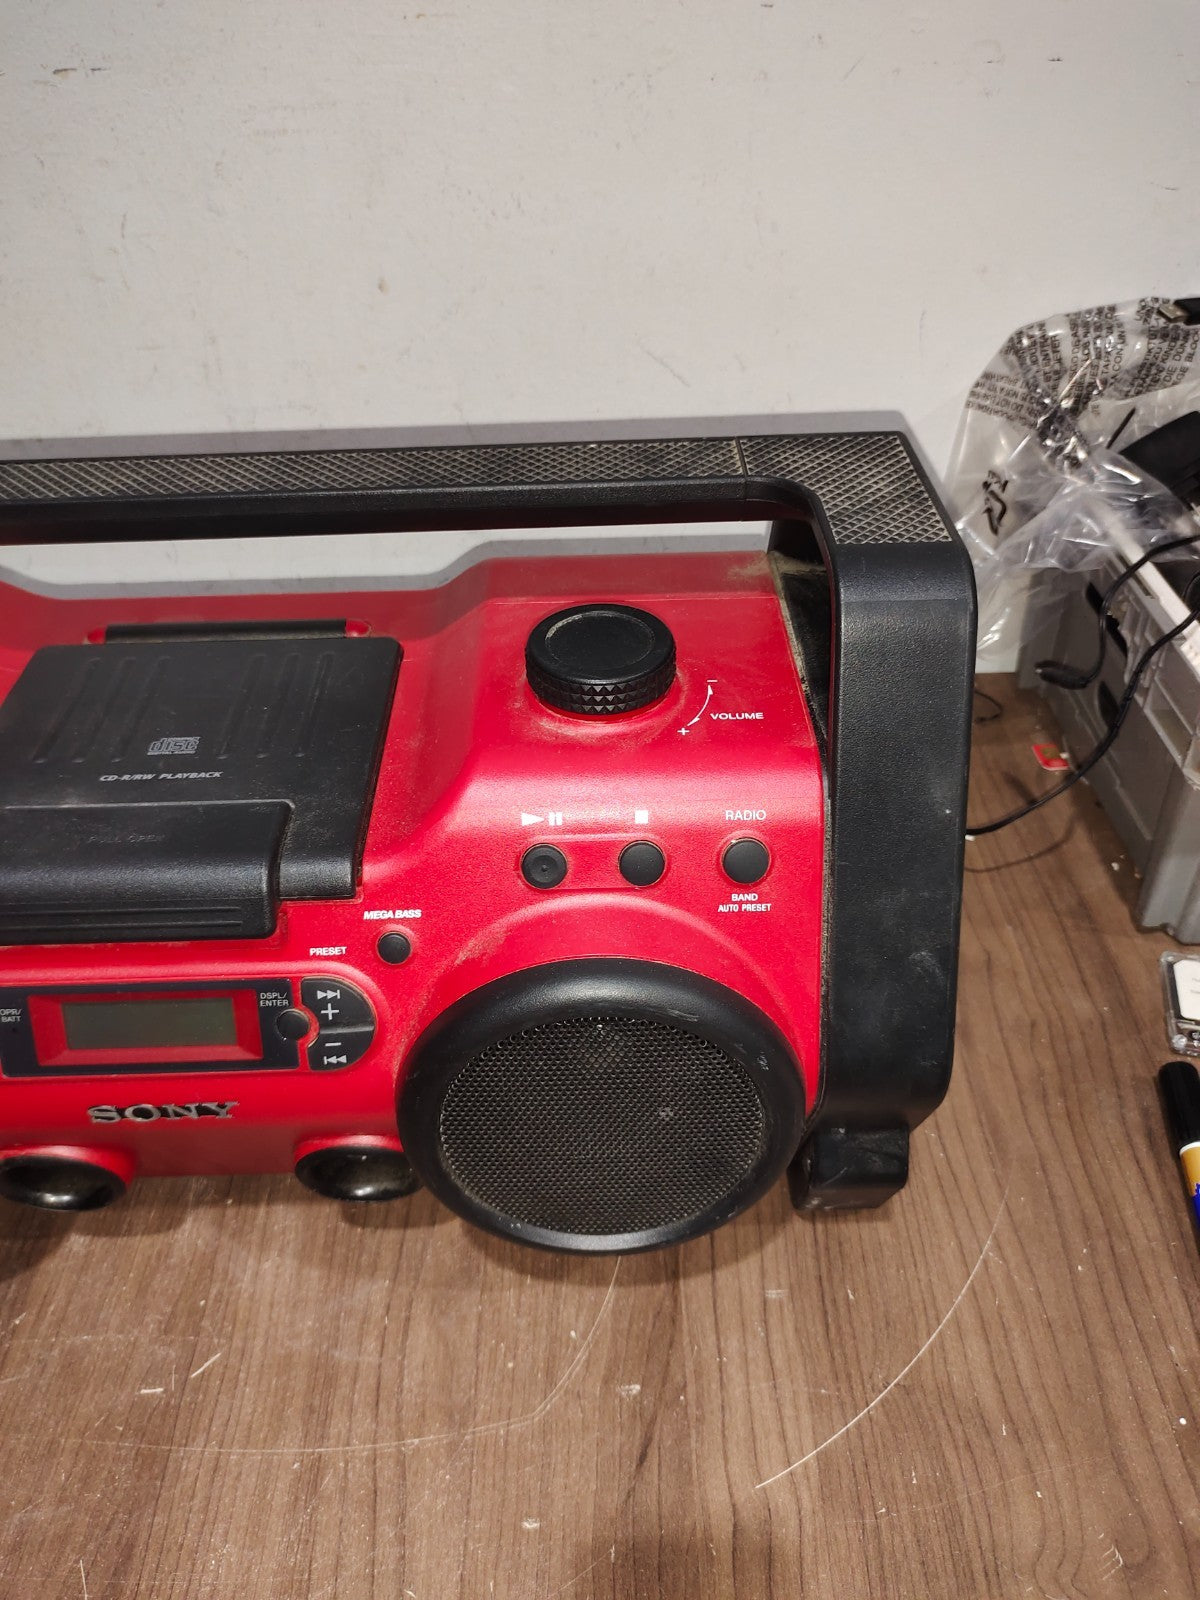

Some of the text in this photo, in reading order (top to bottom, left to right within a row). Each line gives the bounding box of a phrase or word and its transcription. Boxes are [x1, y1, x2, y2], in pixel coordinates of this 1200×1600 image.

[710, 712, 764, 720] VOLUME
[99, 771, 223, 782] CD-R/RW PLAYBACK
[725, 810, 767, 821] RADIO
[731, 893, 758, 902] BAND
[718, 903, 772, 912] AUTO PRESET
[363, 909, 422, 920] MEGA BASS
[309, 946, 347, 956] PRESET
[260, 991, 288, 1000] DSPL/
[260, 999, 289, 1008] ENTER
[87, 1101, 240, 1124] SONY
